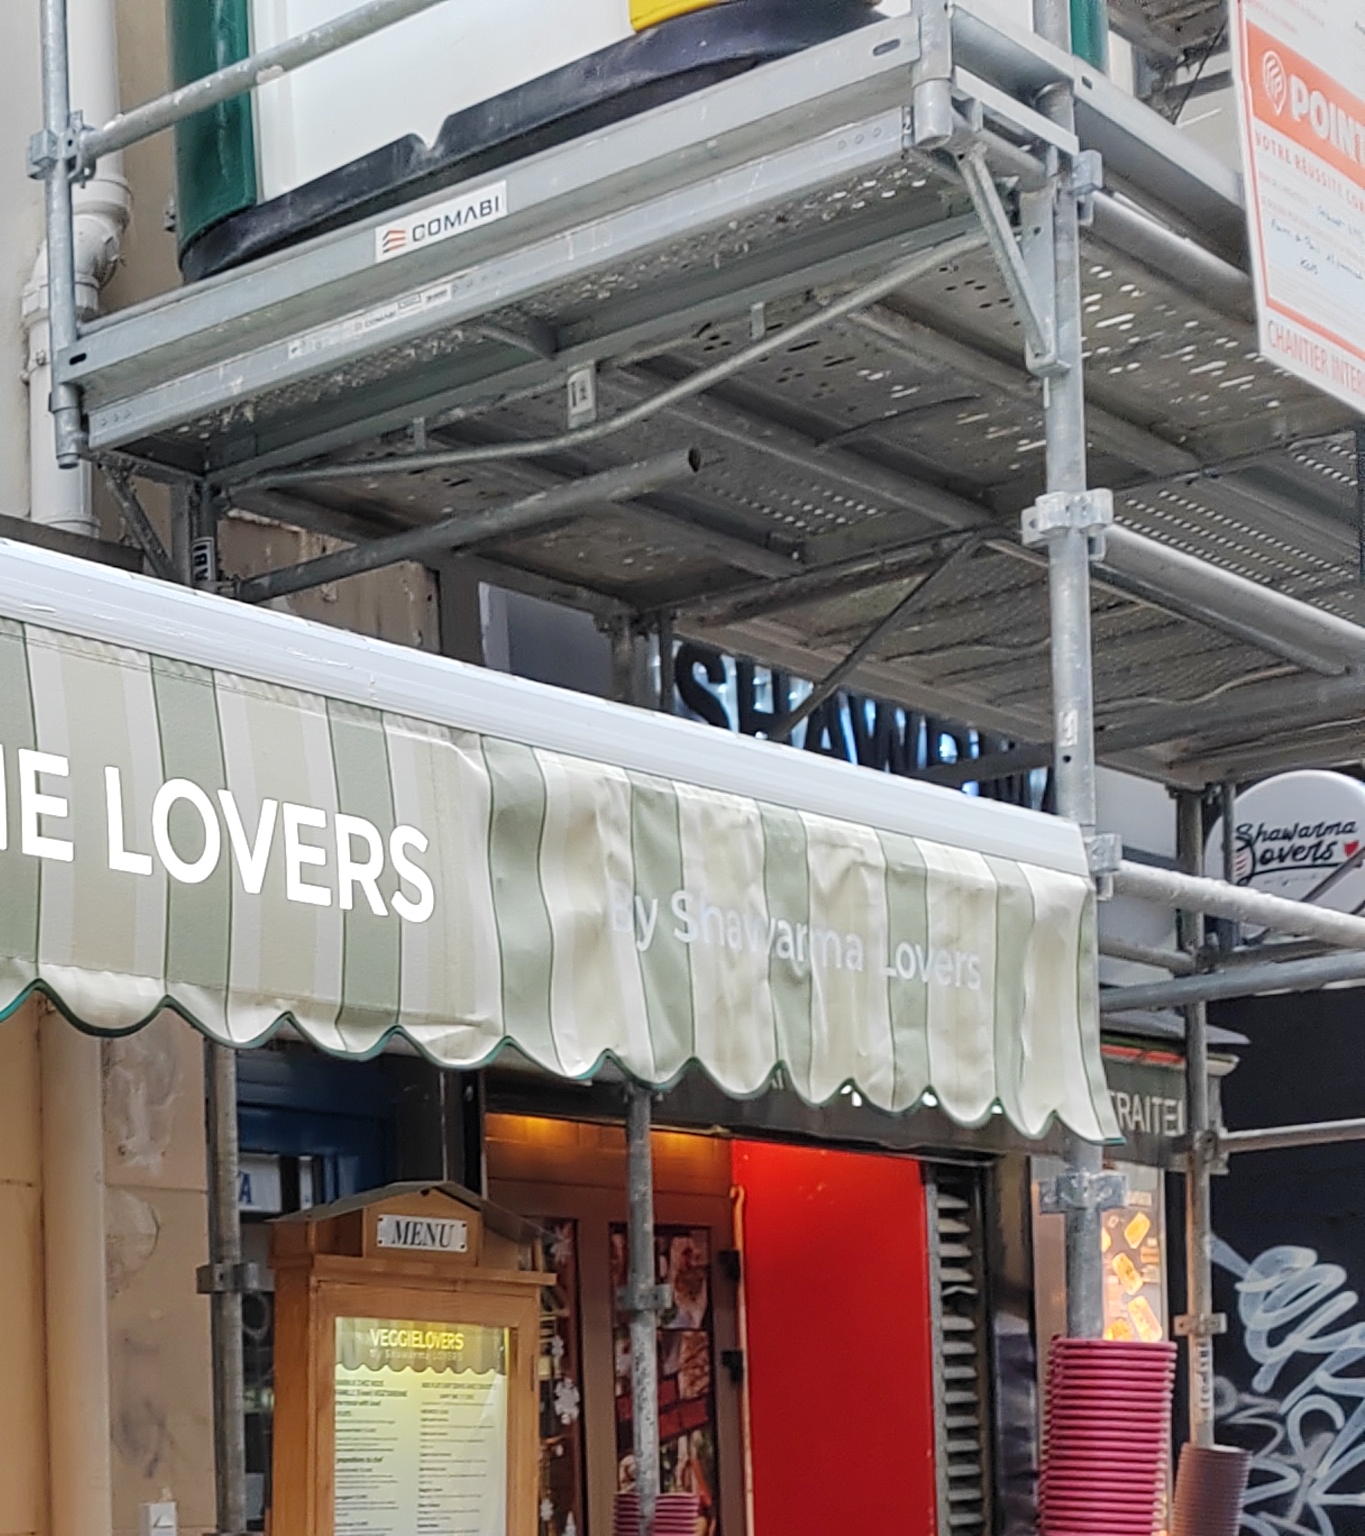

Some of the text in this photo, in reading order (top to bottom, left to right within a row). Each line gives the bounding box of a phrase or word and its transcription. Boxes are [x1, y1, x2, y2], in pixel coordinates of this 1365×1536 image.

[412, 196, 499, 243] COMABI
[1268, 319, 1327, 378] CHANTIER
[103, 766, 435, 924] LOVERS
[1235, 821, 1356, 851] Shawarma
[611, 884, 982, 990] By Shawarma Lovers
[391, 1220, 455, 1248] MENU
[370, 1328, 465, 1350] VEGGIELOVERS
